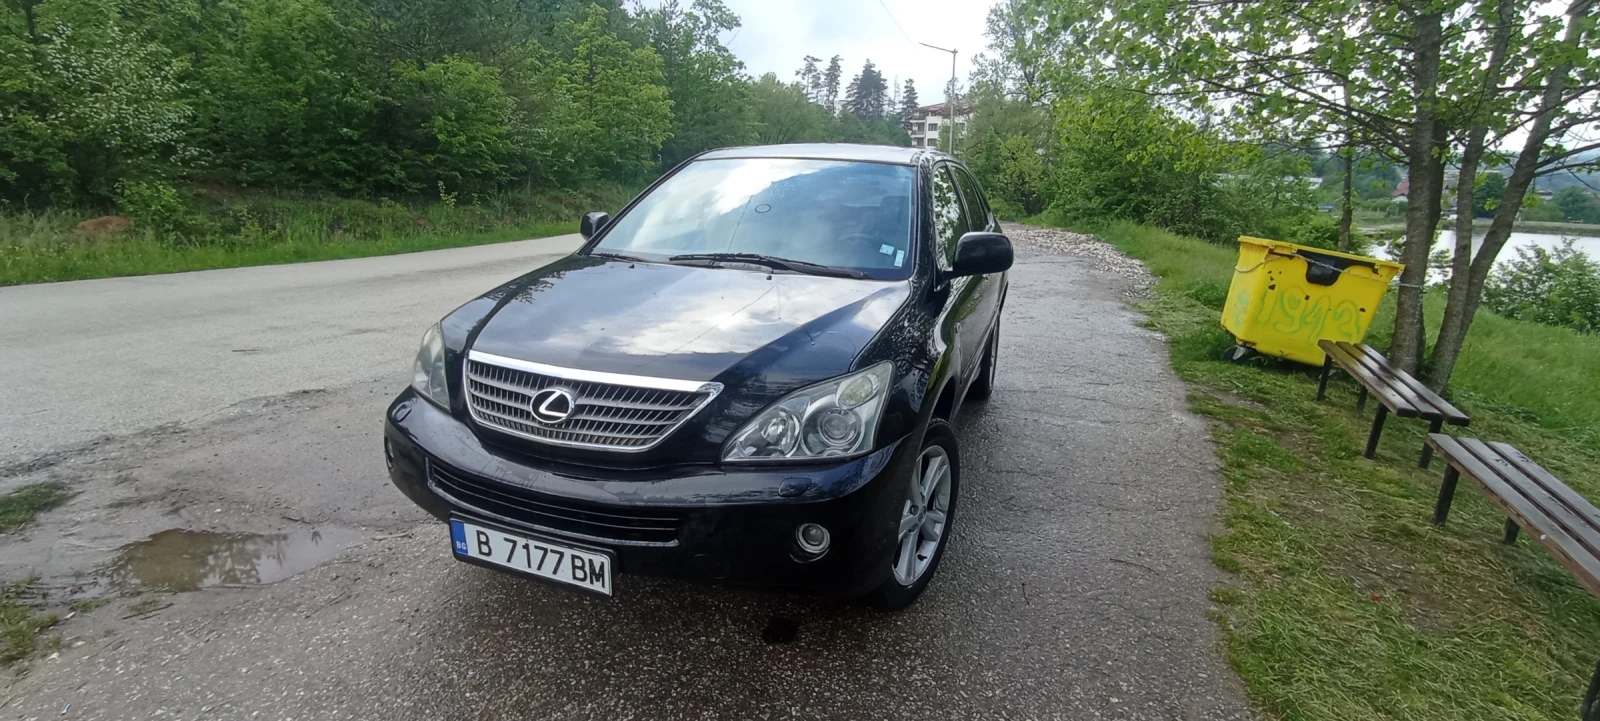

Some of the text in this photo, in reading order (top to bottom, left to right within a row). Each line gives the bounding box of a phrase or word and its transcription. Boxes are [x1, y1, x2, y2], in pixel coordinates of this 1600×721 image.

[456, 541, 467, 550] BG
[476, 530, 605, 588] B 7177 BM
